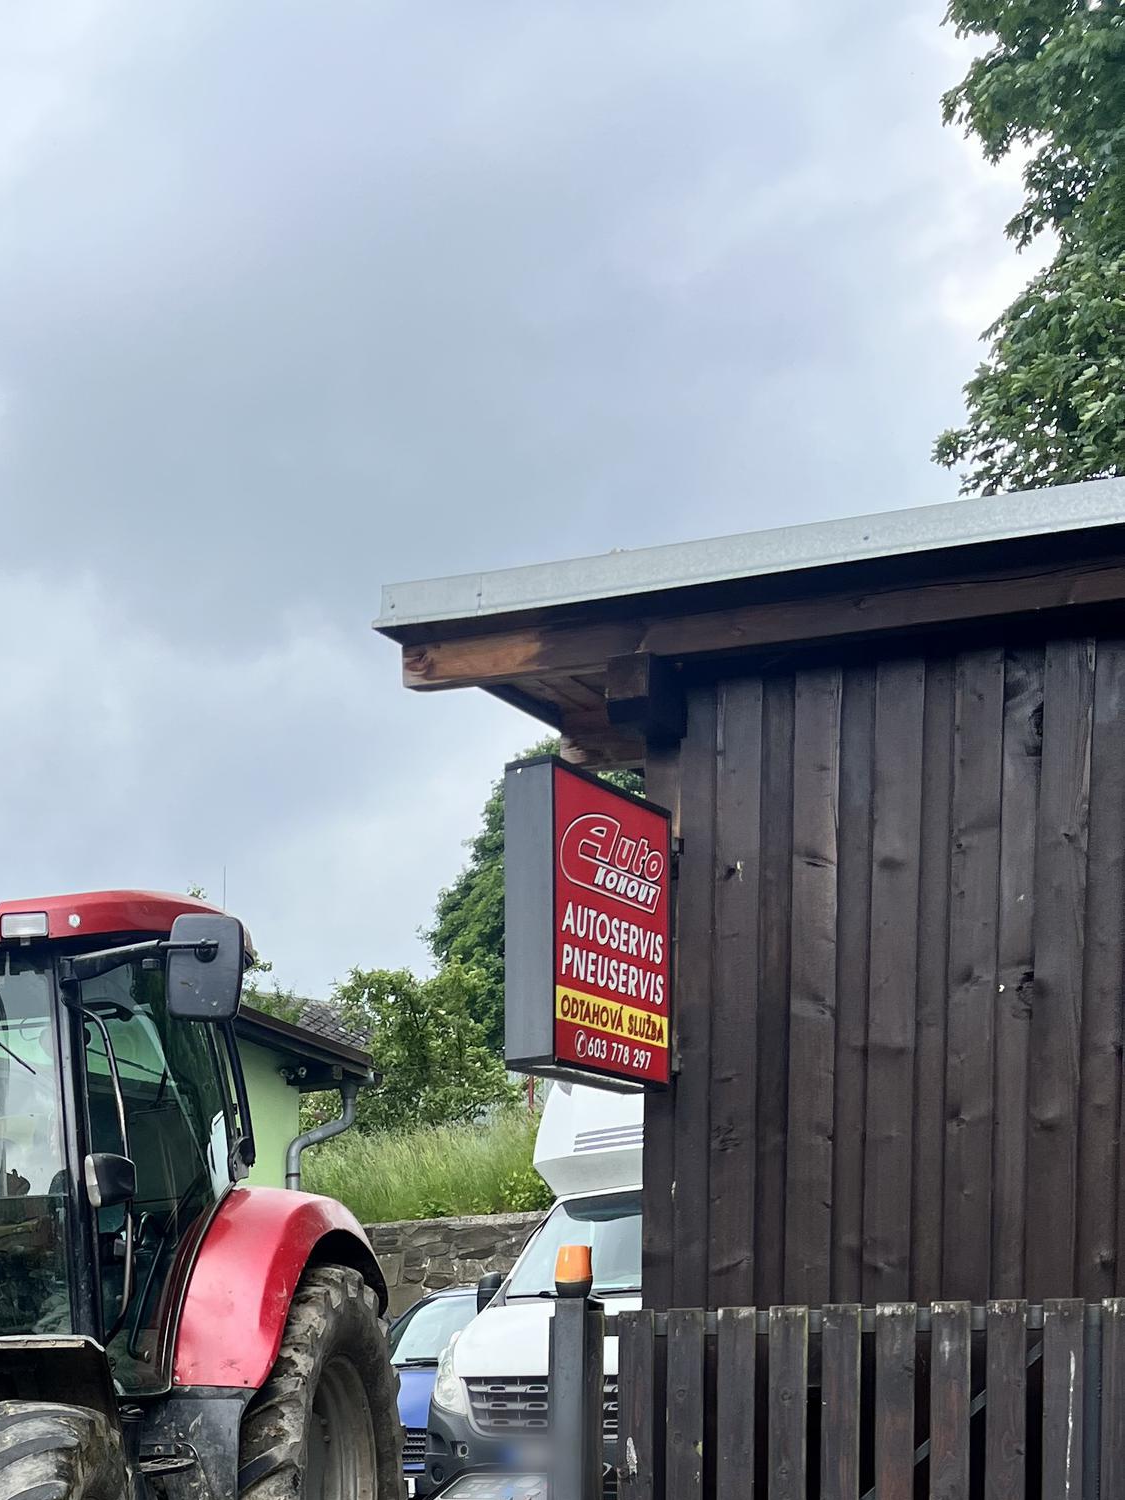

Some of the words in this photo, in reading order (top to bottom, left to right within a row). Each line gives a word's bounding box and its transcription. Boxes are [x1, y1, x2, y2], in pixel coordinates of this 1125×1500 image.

[560, 813, 664, 881] Auto
[594, 866, 657, 906] KOHOUT
[561, 901, 663, 964] AUTOSERVIS
[561, 943, 664, 1005] PNEUSERVIS
[560, 994, 624, 1033] ODTAHOVÁ
[627, 1013, 664, 1044] SLUŽBA
[587, 1036, 607, 1060] 603
[611, 1042, 630, 1066] 778
[632, 1047, 652, 1070] 297
